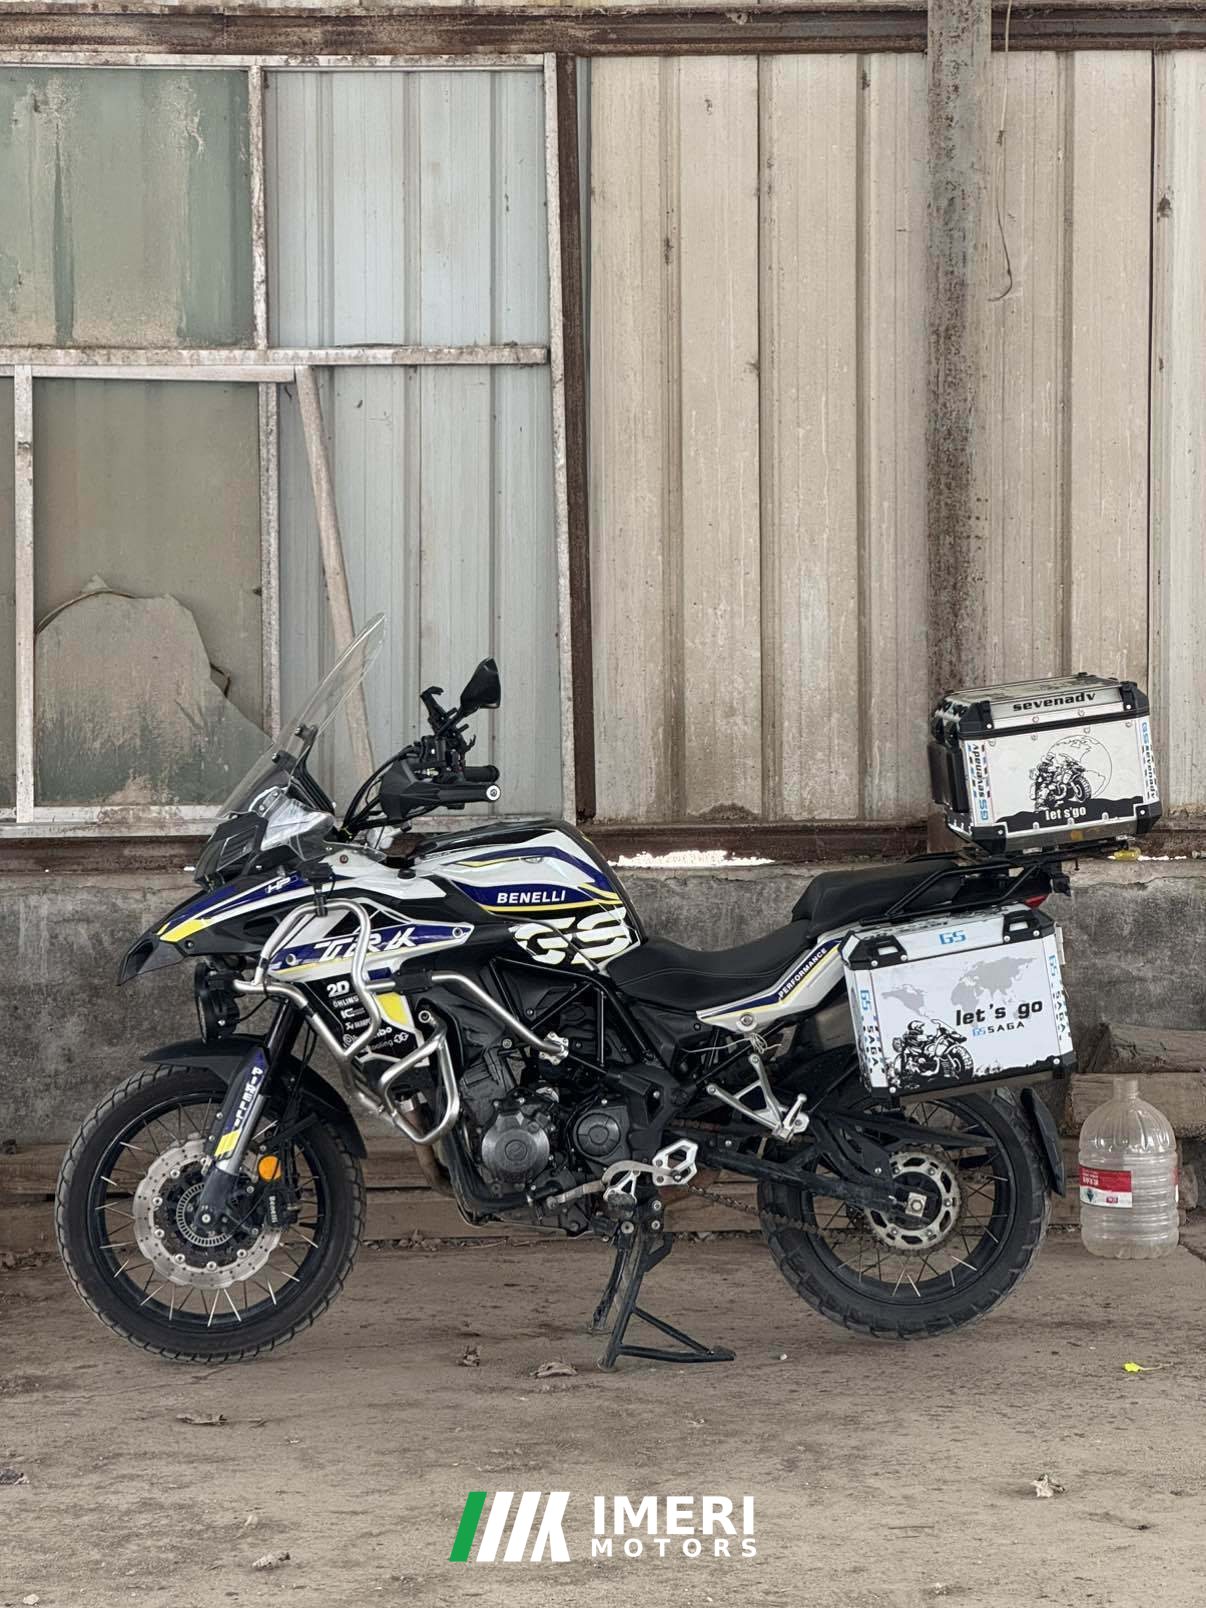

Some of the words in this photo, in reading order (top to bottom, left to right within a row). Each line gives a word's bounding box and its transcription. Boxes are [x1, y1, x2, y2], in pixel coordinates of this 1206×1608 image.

[1013, 692, 1096, 711] sevenadv
[497, 890, 566, 904] BENELLI
[314, 927, 417, 961] TRK
[512, 907, 632, 966] GS
[939, 930, 967, 945] GS
[777, 947, 827, 999] PERFORMANCE
[326, 980, 350, 998] 2D
[860, 990, 871, 1010] GS
[867, 1025, 879, 1066] SAGA
[956, 1003, 1007, 1026] let's
[1018, 1001, 1043, 1019] go
[234, 1066, 264, 1128] PIRELLI
